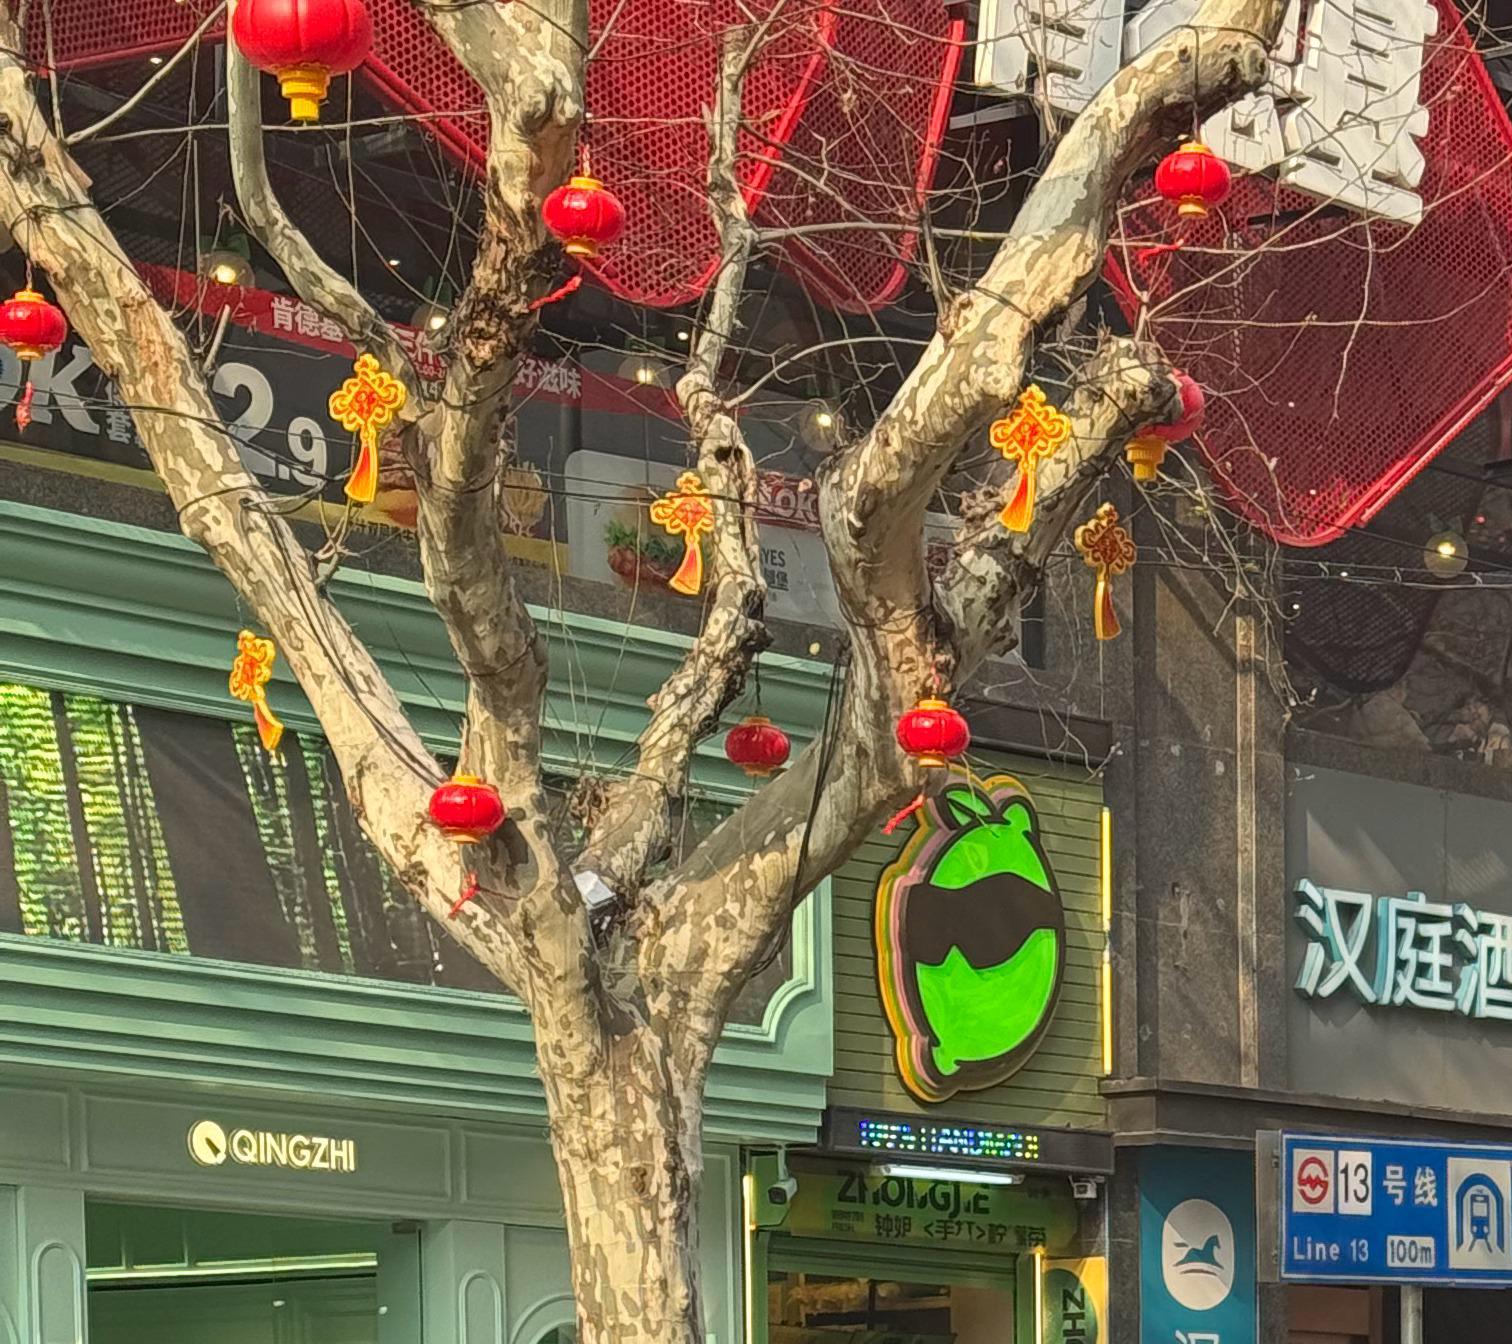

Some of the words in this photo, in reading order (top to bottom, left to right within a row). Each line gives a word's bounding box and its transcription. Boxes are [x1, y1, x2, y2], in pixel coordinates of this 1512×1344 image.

[514, 353, 583, 400] 好滋味
[230, 1128, 356, 1173] QINGZHI
[1339, 1160, 1370, 1203] 13
[1383, 1166, 1438, 1208] 号线
[1293, 1236, 1341, 1261] Line
[1349, 1239, 1370, 1261] 13
[1388, 1240, 1435, 1266] 100m
